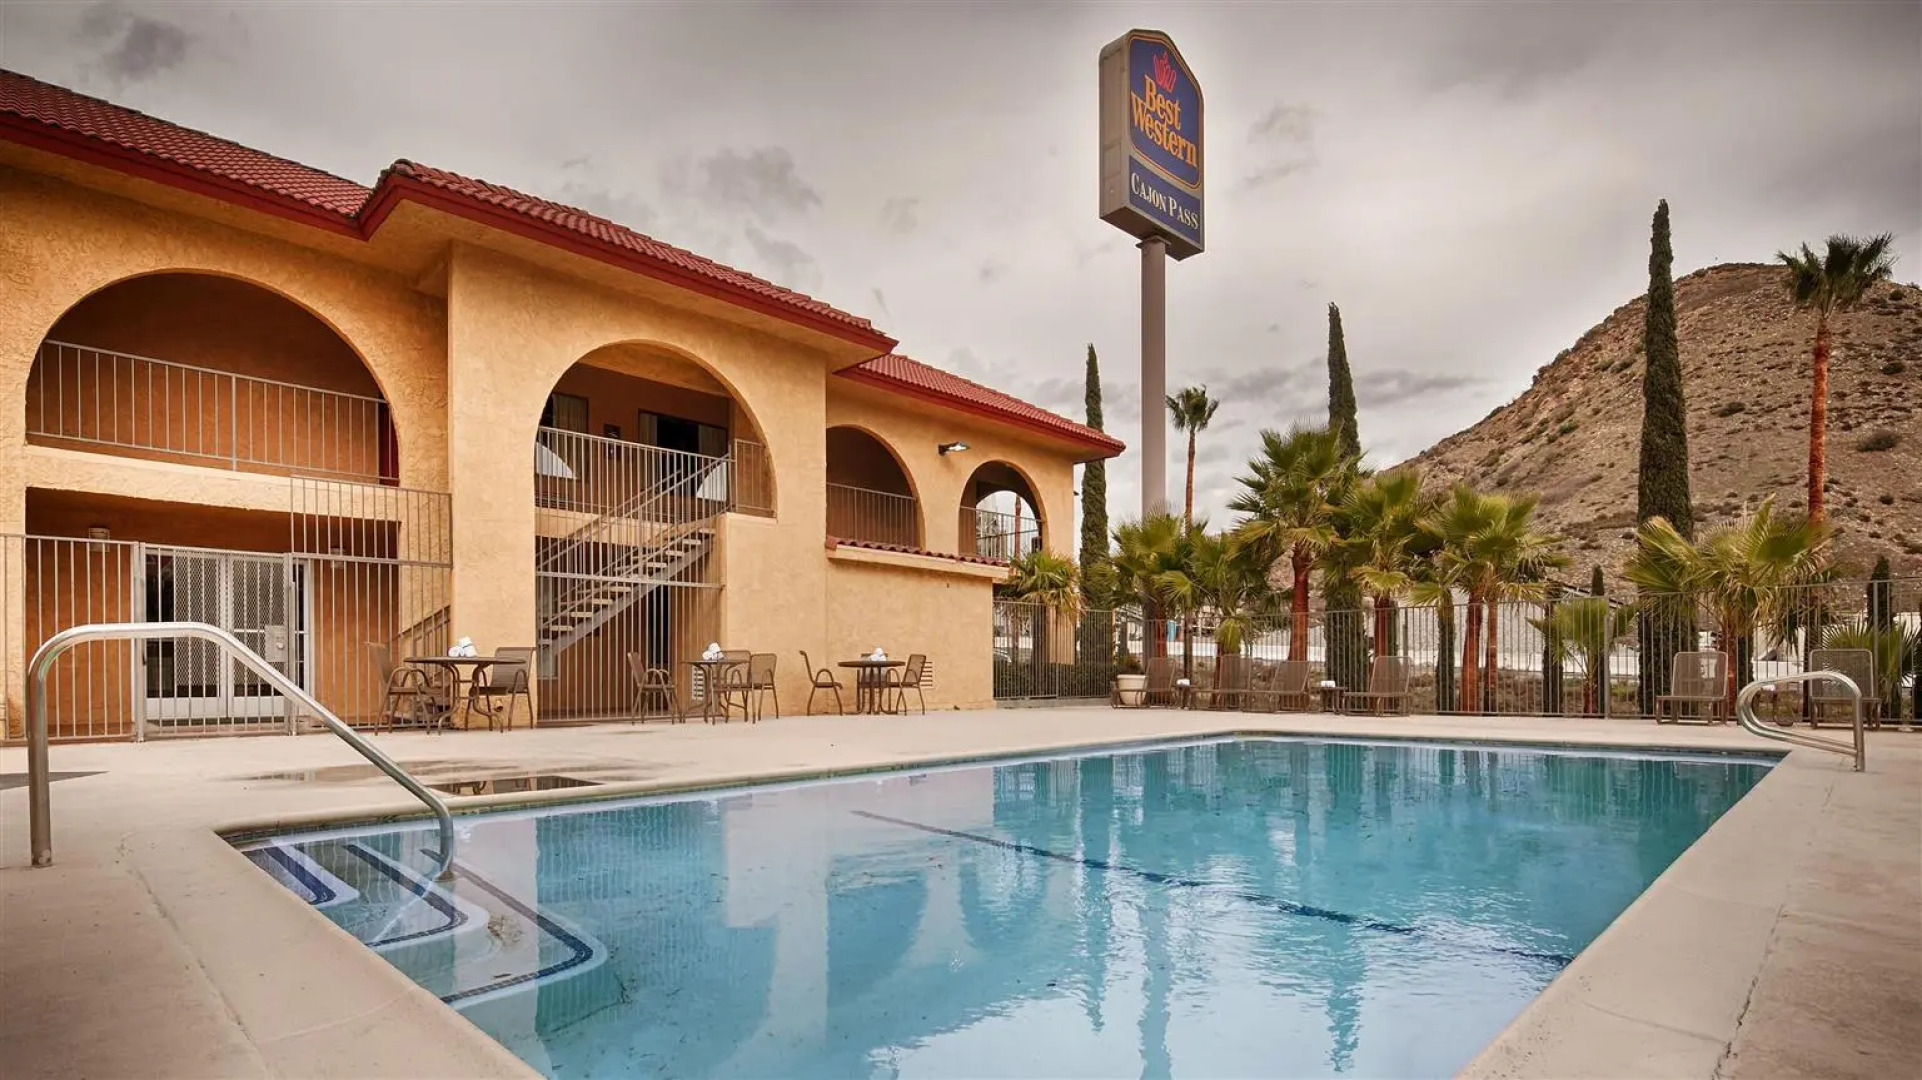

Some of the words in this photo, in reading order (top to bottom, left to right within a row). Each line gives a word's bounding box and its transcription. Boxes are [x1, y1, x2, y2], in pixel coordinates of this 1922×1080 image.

[1131, 91, 1198, 168] Western
[1144, 74, 1182, 130] Best
[1131, 172, 1167, 212] CAJON
[1168, 194, 1199, 230] PASS
